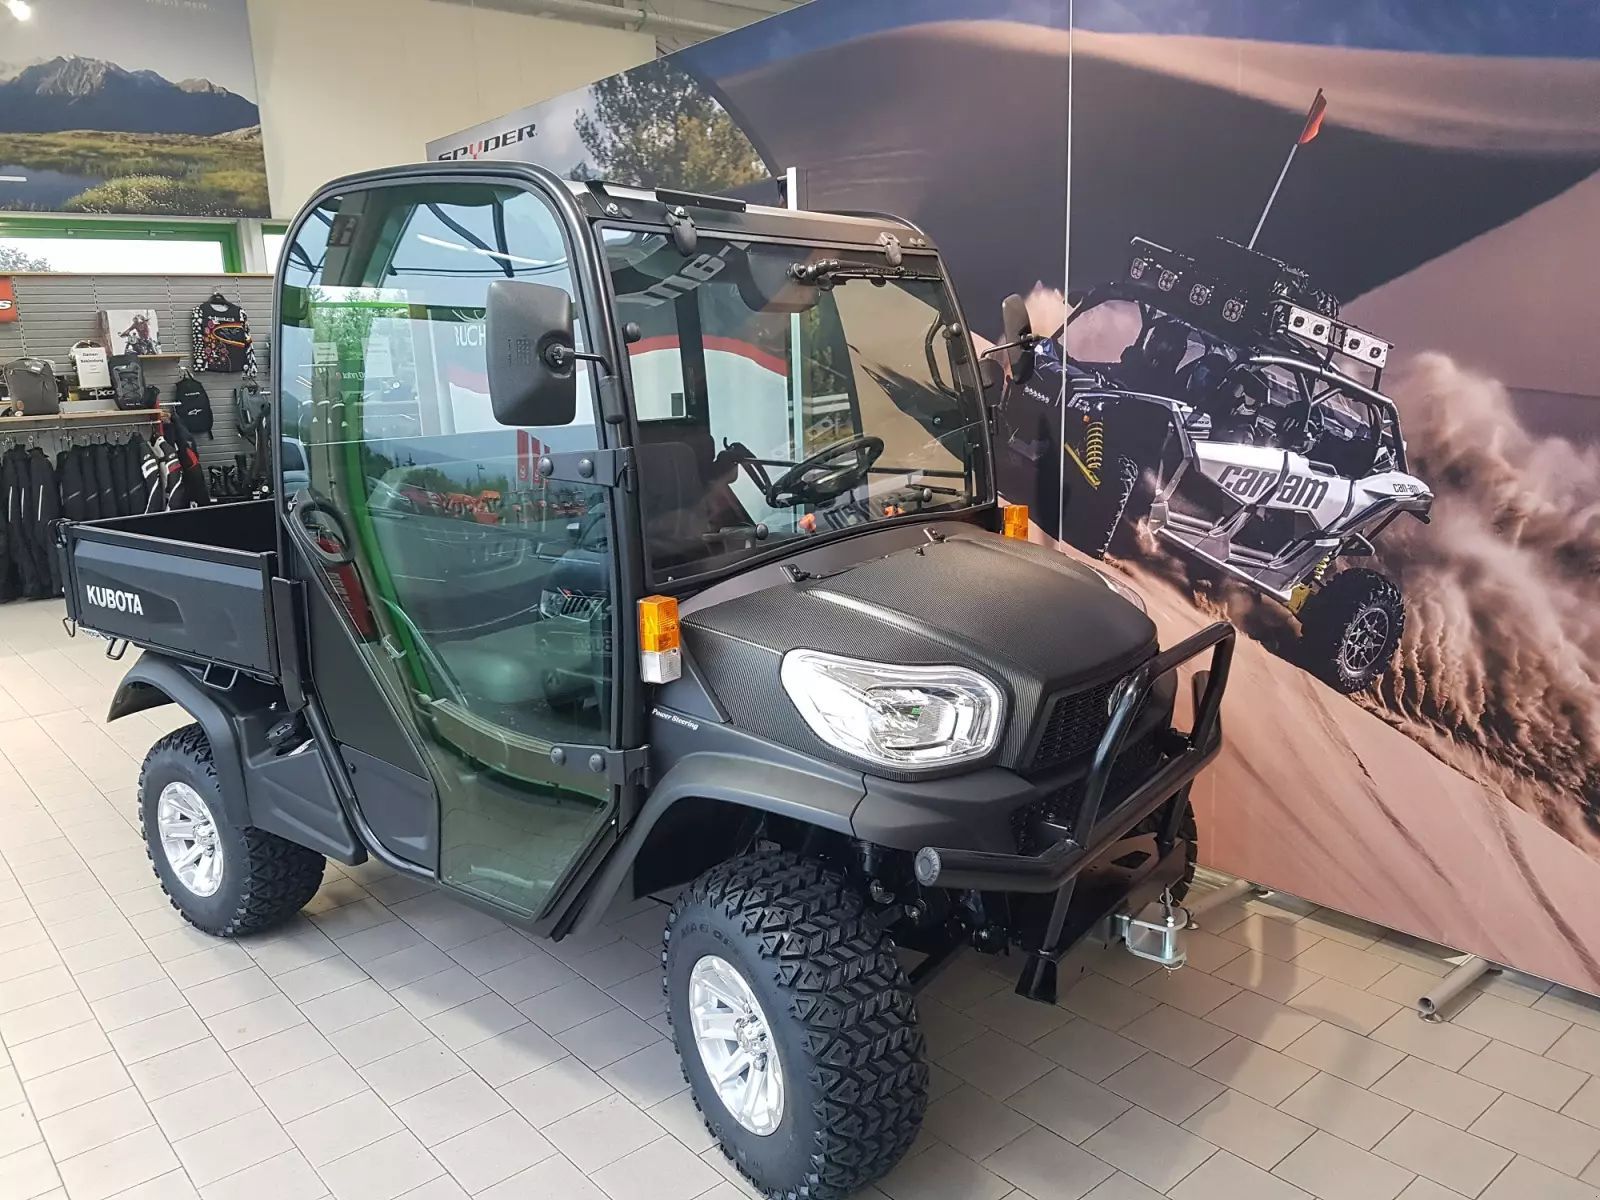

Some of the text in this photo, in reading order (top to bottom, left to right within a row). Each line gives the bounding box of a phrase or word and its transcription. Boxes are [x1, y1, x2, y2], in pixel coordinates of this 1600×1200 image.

[1217, 465, 1329, 510] canam
[86, 584, 144, 616] KUBOTA
[671, 715, 699, 731] Steering
